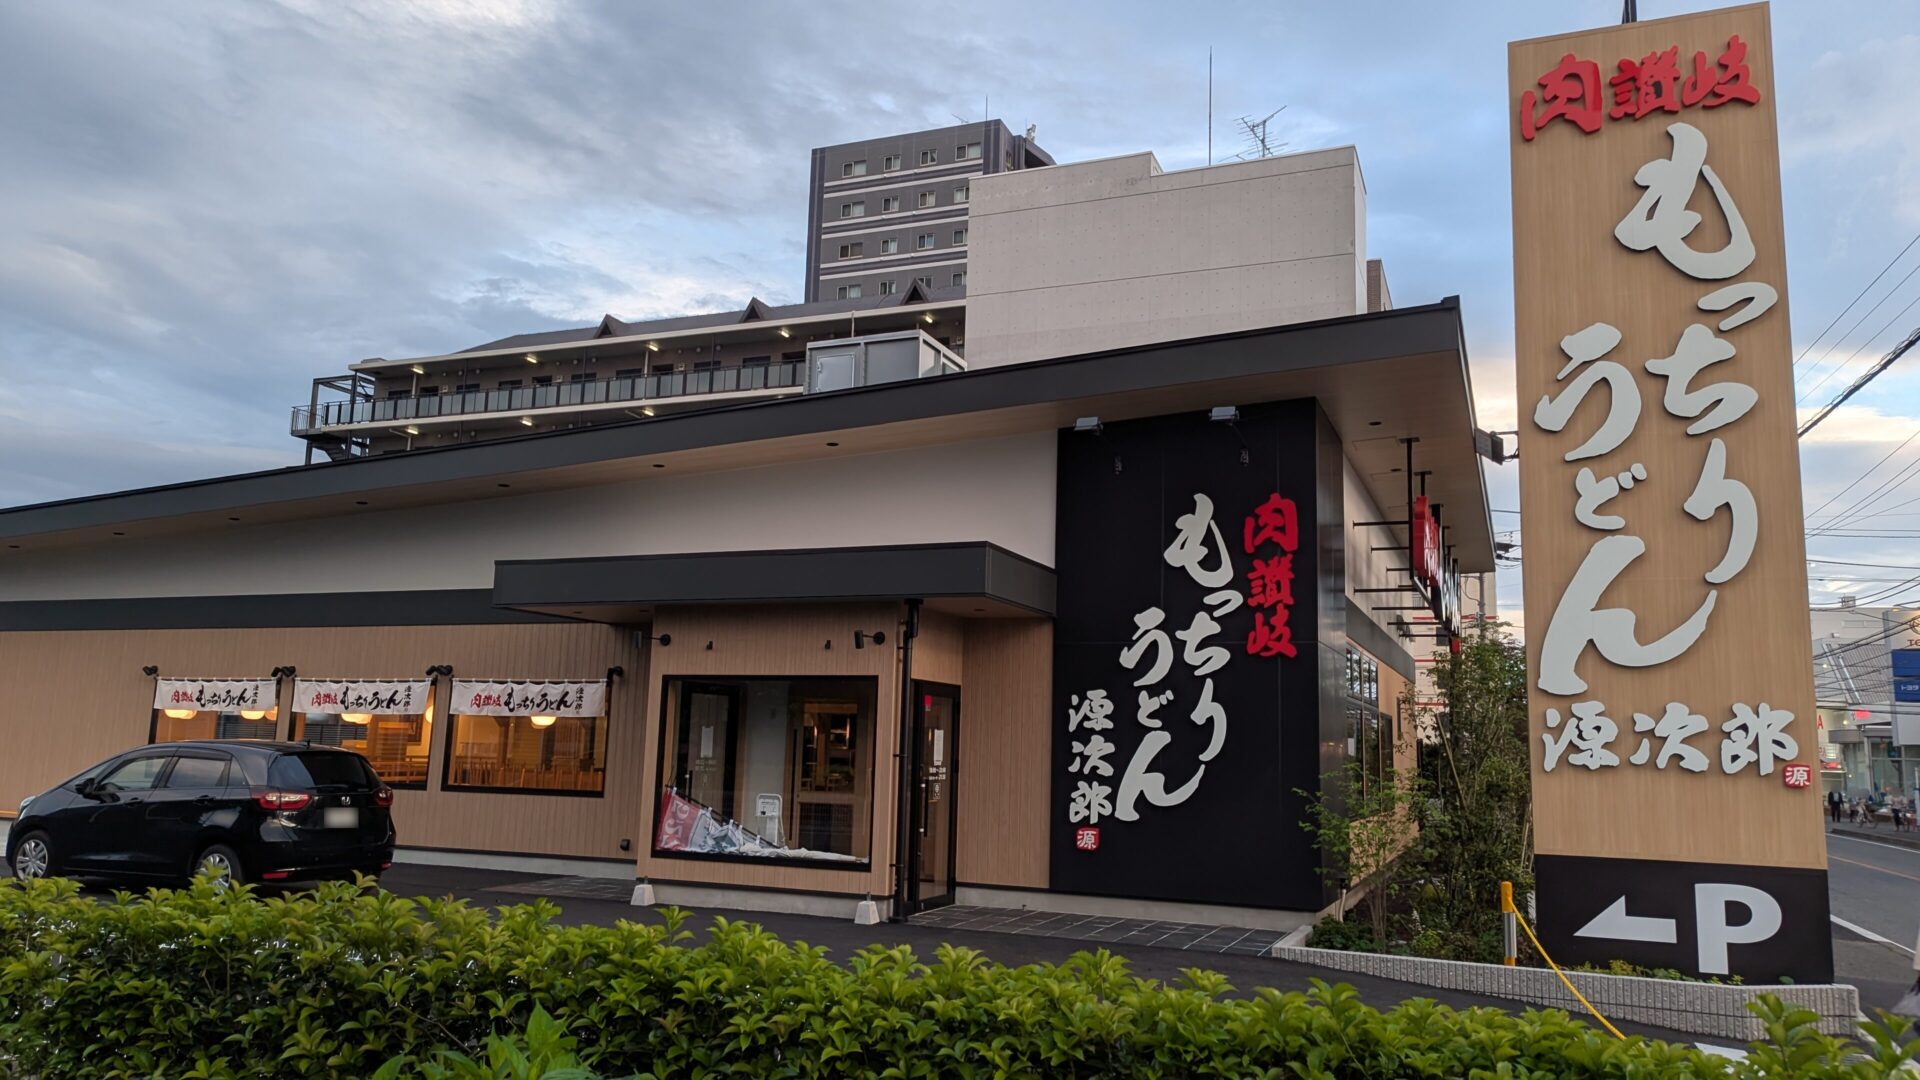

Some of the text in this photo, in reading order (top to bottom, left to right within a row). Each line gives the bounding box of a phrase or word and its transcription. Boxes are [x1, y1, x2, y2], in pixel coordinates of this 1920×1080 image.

[1613, 122, 1779, 584] もっちり
[1533, 322, 1719, 696] うどん
[1163, 492, 1244, 762] もっちり
[1068, 689, 1116, 824] 源次郎
[1114, 606, 1206, 822] うどん
[1541, 701, 1800, 777] 源次郎
[1785, 766, 1811, 786] 源
[1077, 830, 1099, 850] 源
[1694, 883, 1782, 975] P
